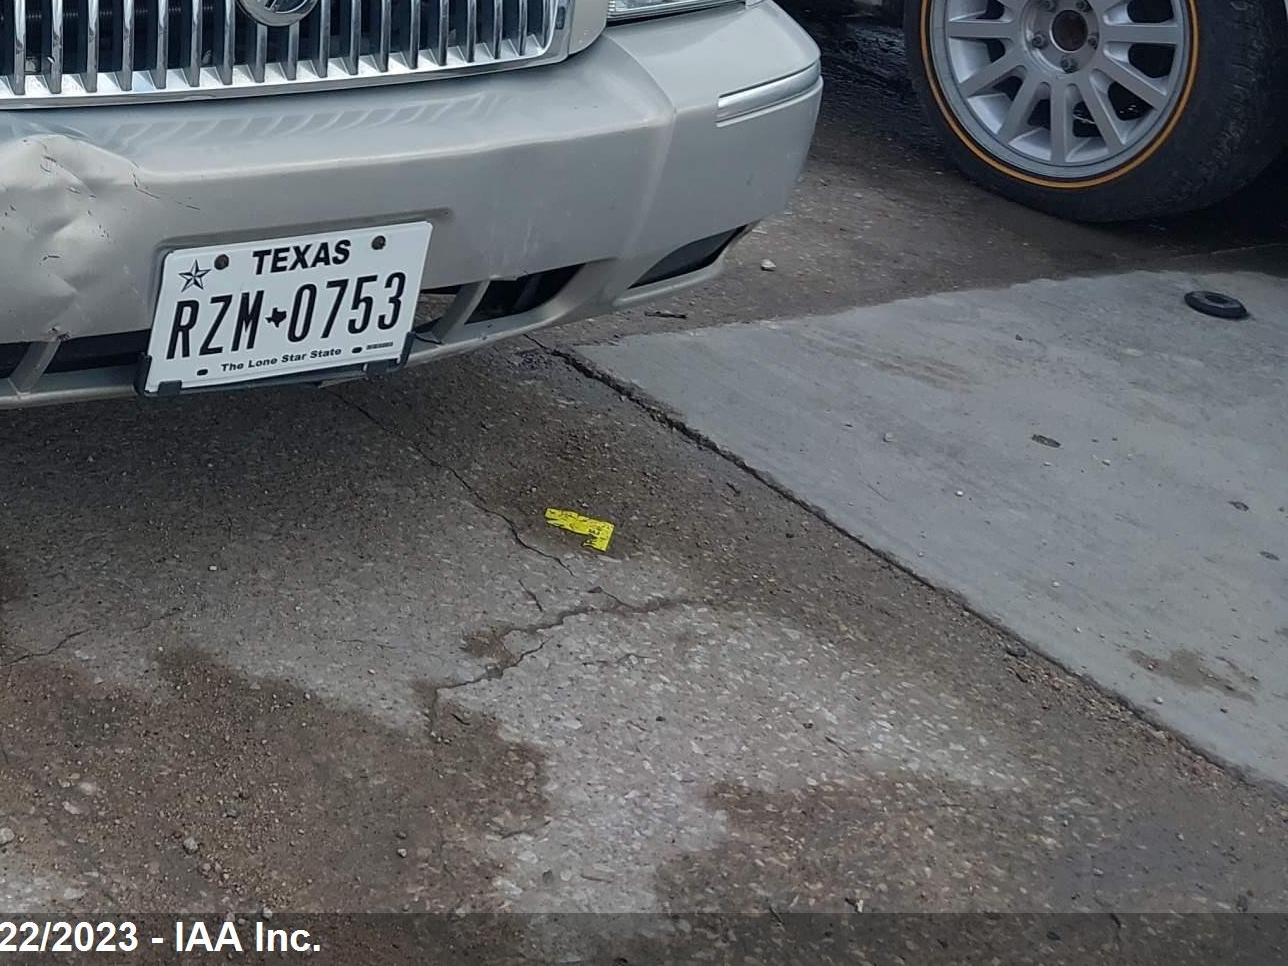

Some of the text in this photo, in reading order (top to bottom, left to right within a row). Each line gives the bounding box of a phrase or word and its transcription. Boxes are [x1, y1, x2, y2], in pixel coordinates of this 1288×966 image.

[252, 239, 352, 275] TEXAS
[165, 271, 407, 360] RZM 0753
[221, 348, 342, 373] The Lone Star State
